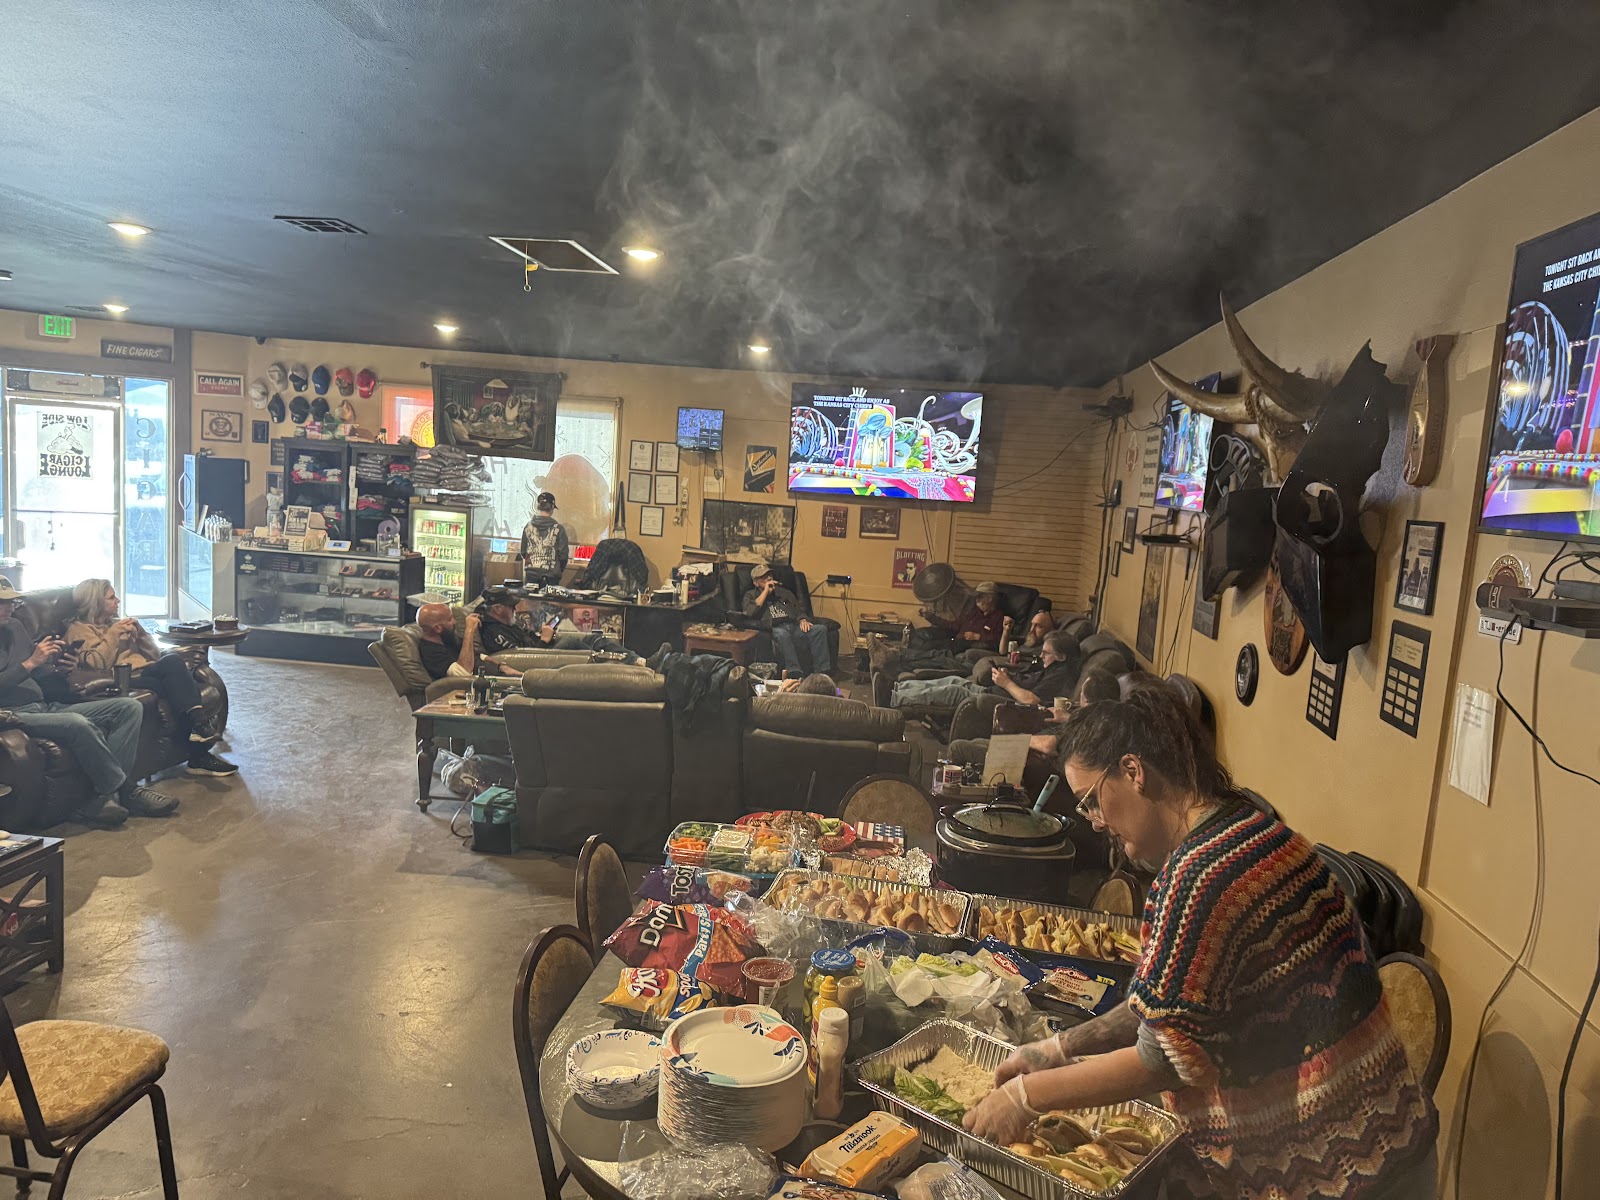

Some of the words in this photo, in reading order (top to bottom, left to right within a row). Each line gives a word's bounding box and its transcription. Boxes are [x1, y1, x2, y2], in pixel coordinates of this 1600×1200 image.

[1545, 259, 1568, 276] TONIGHT
[1568, 256, 1578, 268] SIT
[1577, 250, 1593, 266] BACK
[1542, 280, 1554, 292] THE
[1552, 274, 1574, 290] KANSAS
[1574, 269, 1588, 284] CITY
[44, 315, 72, 336] EXIT
[106, 344, 128, 355] FINE
[128, 346, 160, 358] CIGARS
[200, 376, 216, 385] CALL
[218, 378, 240, 386] AGAIN
[896, 550, 925, 562] BLUFFING
[694, 926, 711, 958] Party
[838, 1125, 874, 1153] Tillamook
